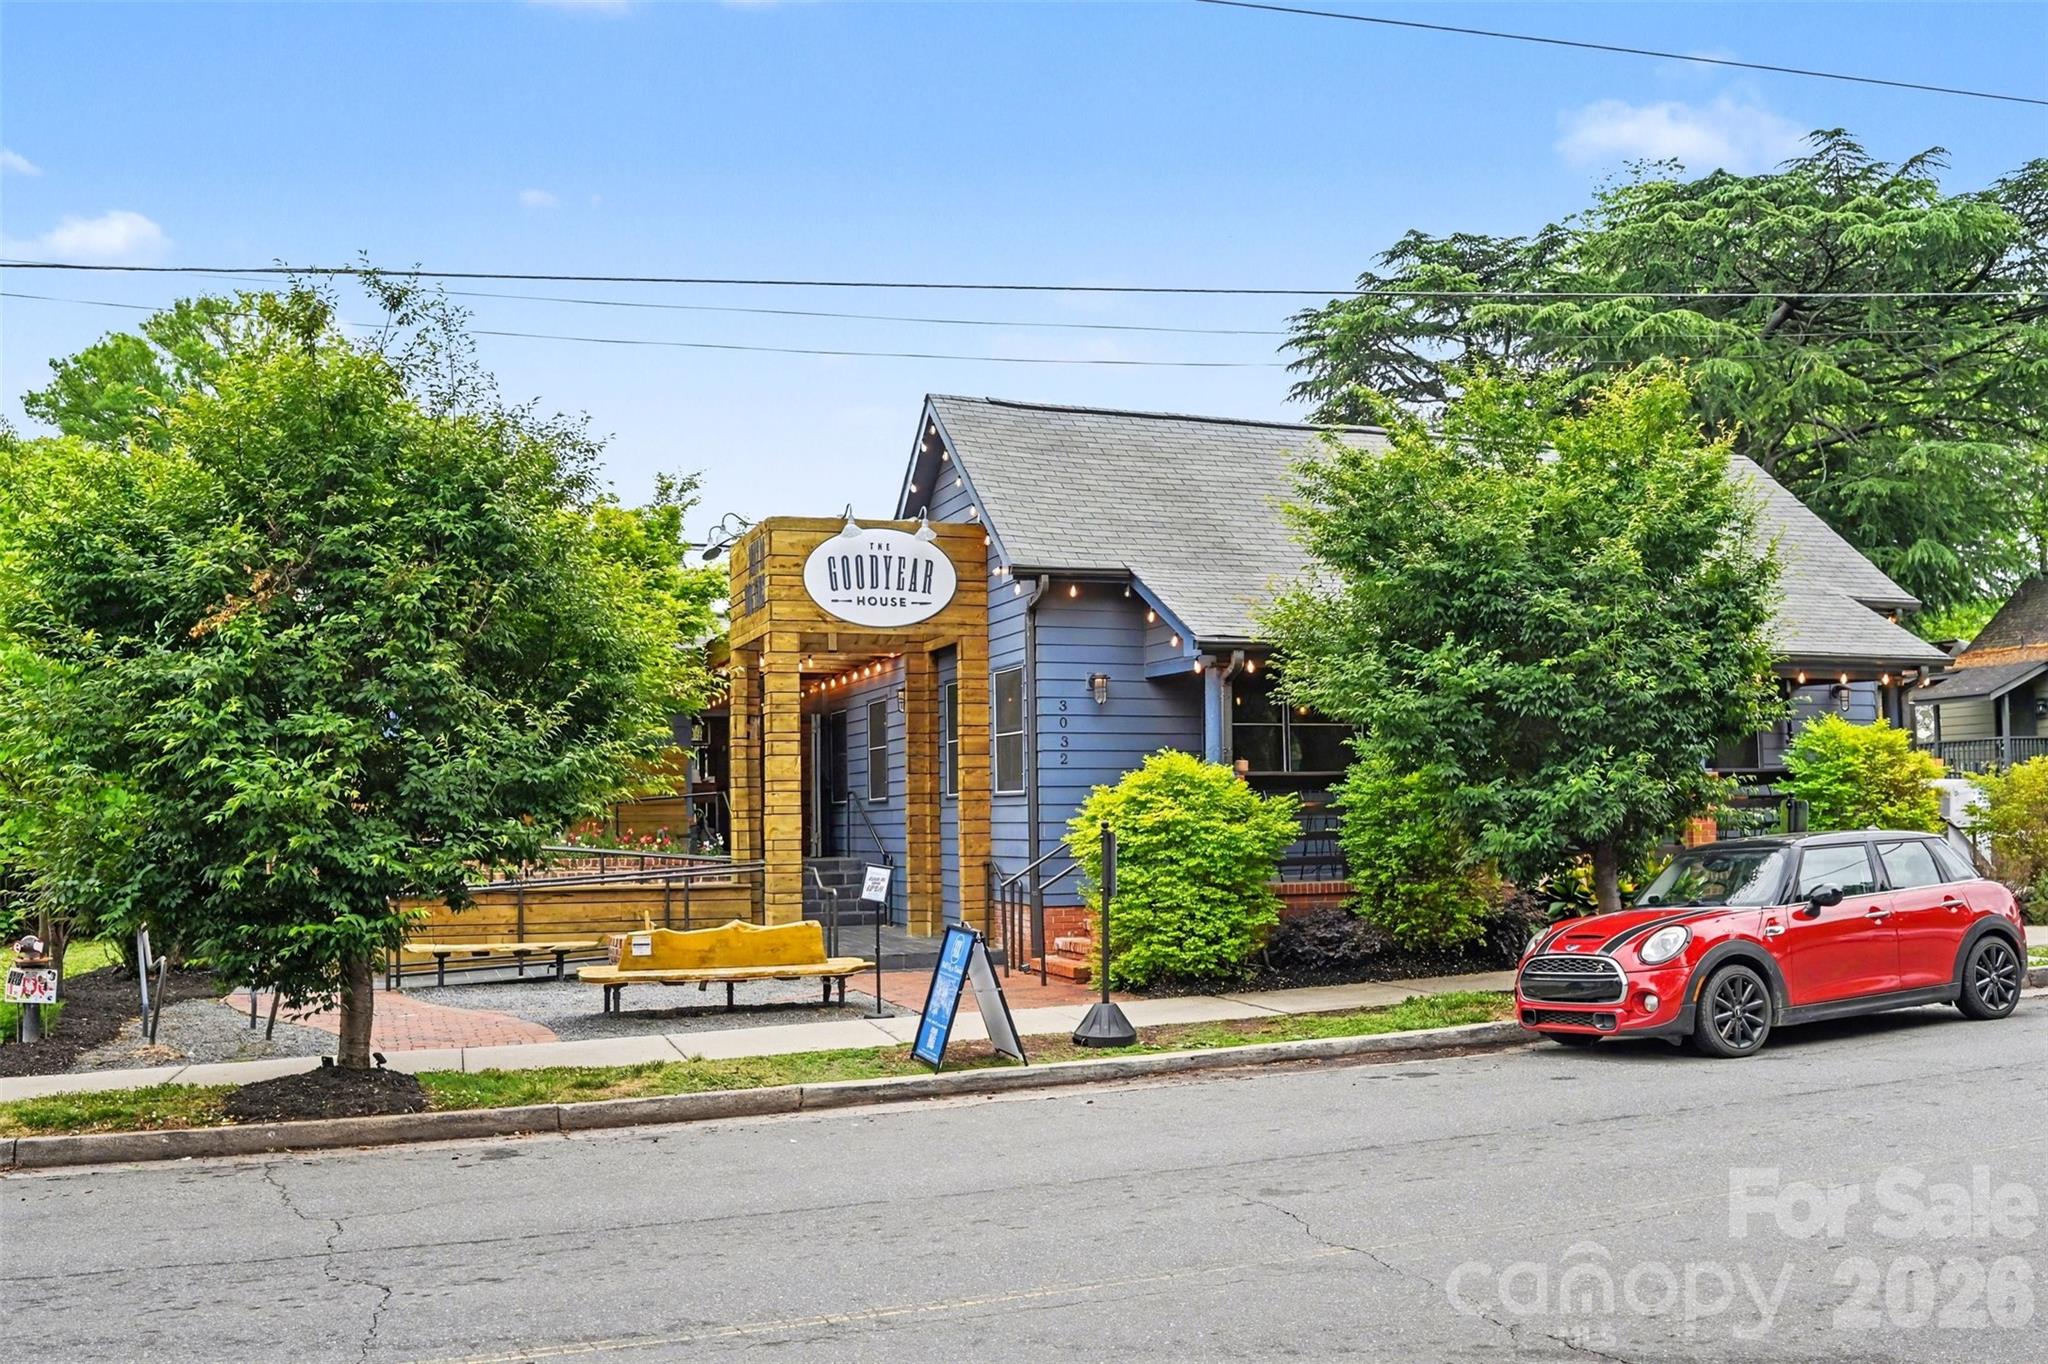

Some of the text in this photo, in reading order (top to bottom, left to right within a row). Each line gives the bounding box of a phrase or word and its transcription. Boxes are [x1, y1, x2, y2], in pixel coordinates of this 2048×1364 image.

[870, 542, 890, 551] THE
[827, 554, 934, 595] GOODYEAR
[857, 596, 907, 607] HOUSE
[1059, 700, 1069, 765] 3032
